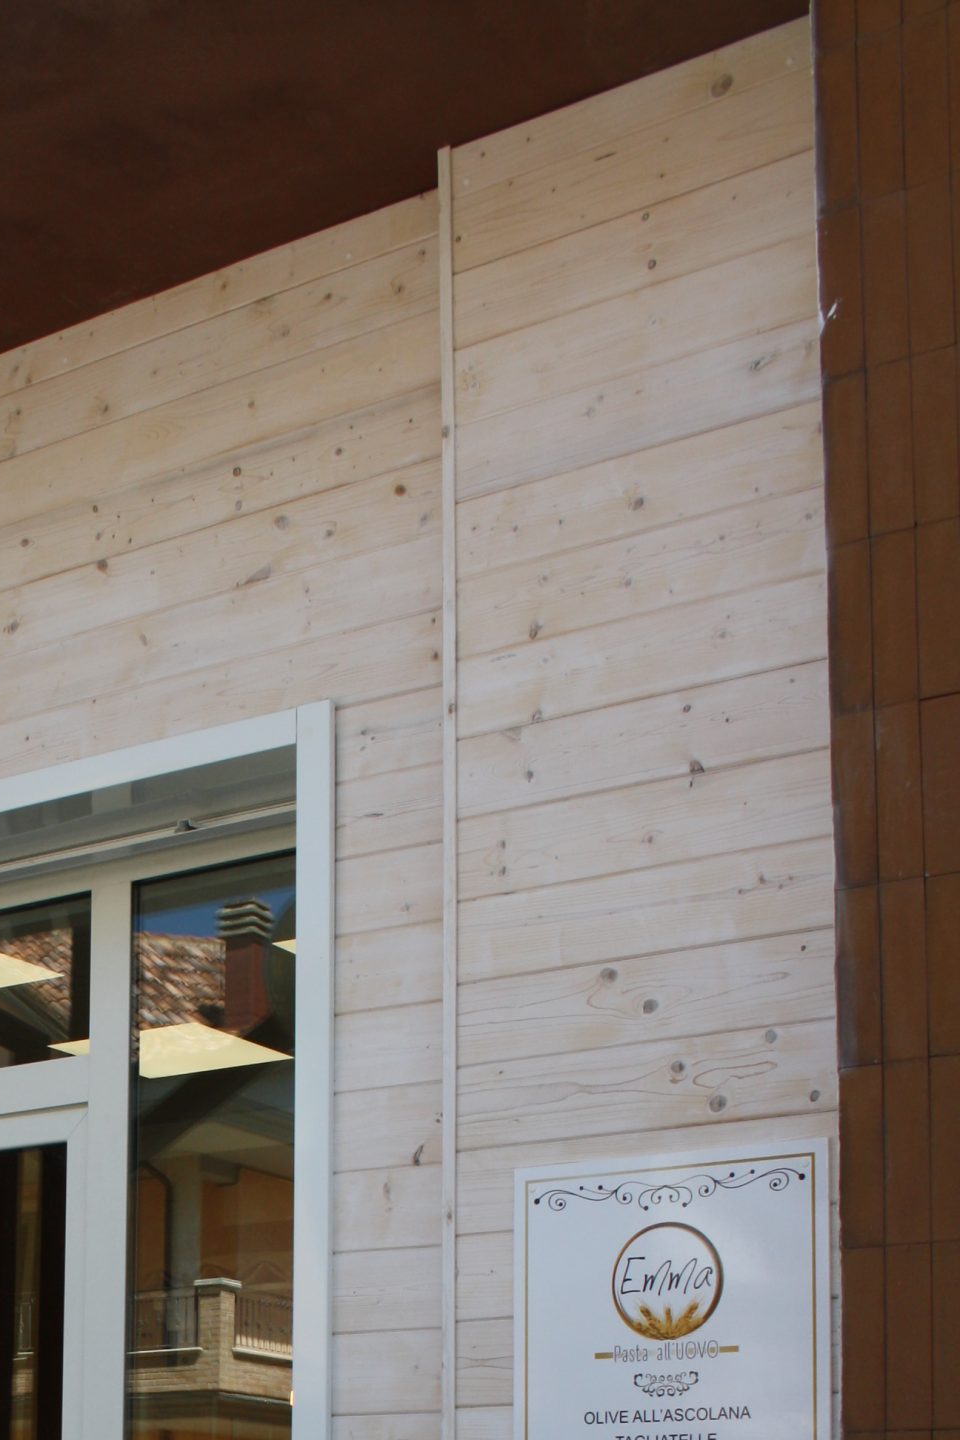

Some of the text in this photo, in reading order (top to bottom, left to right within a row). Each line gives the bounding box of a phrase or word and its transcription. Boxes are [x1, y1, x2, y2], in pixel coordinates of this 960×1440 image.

[614, 1345, 648, 1363] Pasta
[584, 1405, 751, 1425] OLIVE ALL'ASCOLANA
